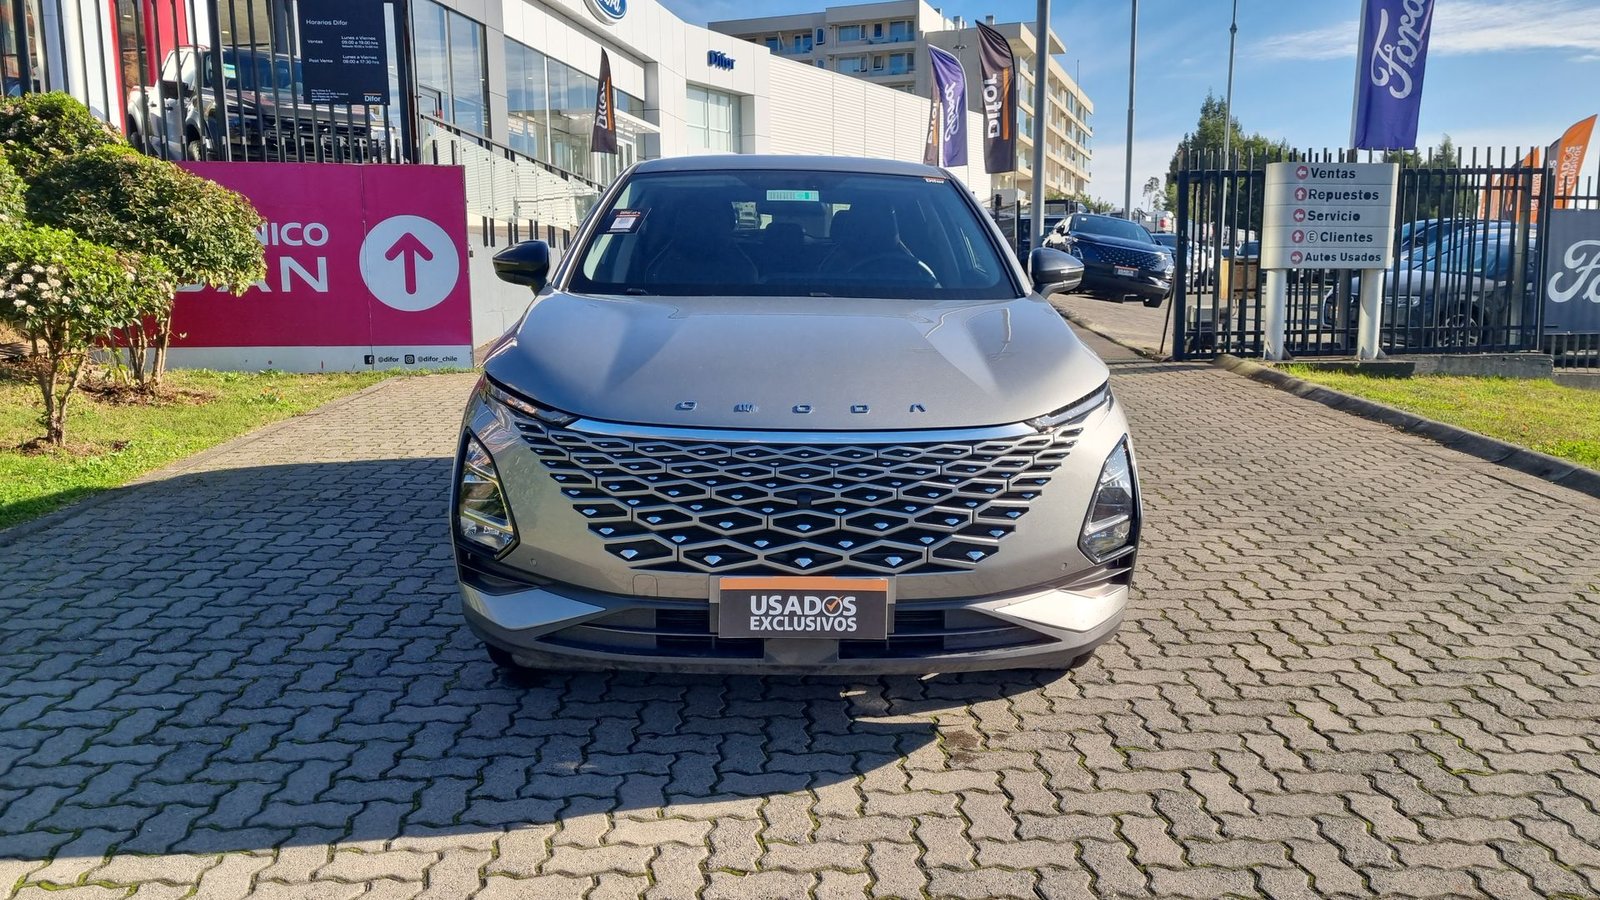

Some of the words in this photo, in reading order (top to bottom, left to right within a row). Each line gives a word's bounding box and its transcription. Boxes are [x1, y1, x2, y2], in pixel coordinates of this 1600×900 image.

[1311, 167, 1356, 179] Ventas
[1308, 188, 1379, 202] Repuestos
[1307, 210, 1361, 221] Servicio
[1320, 231, 1373, 243] Clientes
[1304, 252, 1337, 262] Autos
[1340, 252, 1382, 262] Usados
[750, 595, 857, 617] USADOS
[750, 616, 857, 632] EXCLUSIVOS
